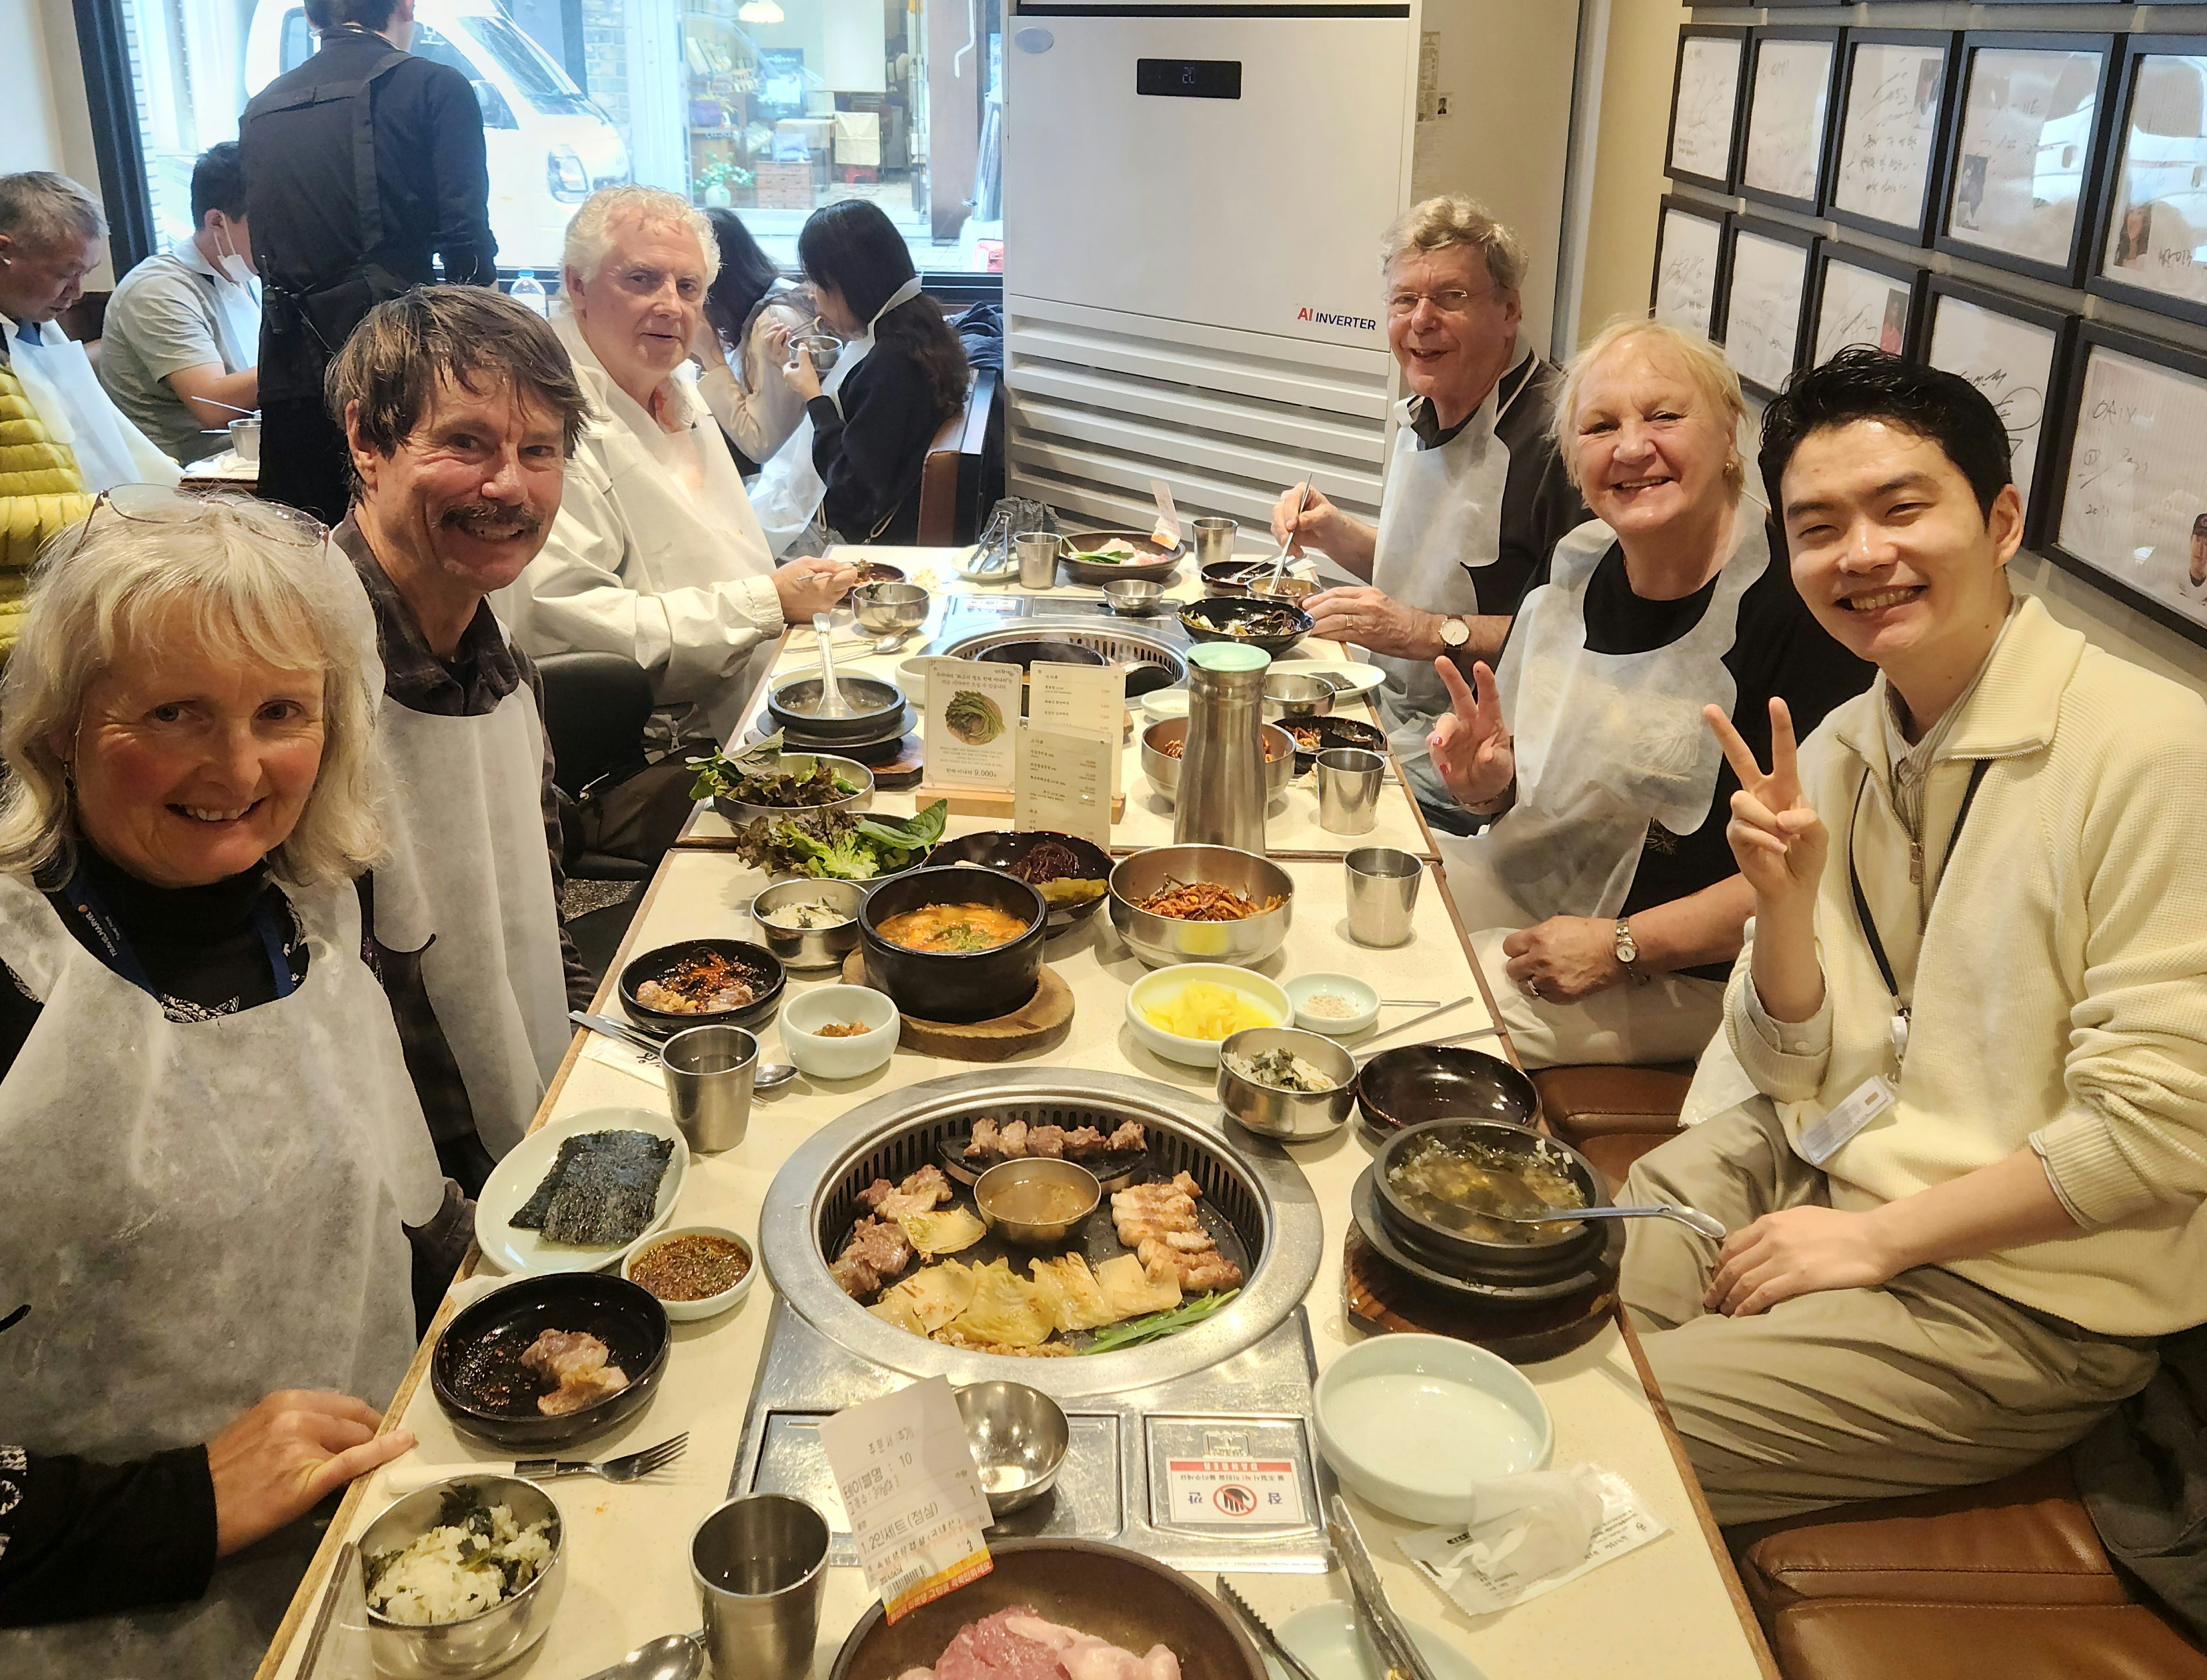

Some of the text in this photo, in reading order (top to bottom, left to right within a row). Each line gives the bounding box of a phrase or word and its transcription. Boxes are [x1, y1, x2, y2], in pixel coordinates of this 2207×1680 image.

[1297, 307, 1376, 330] AI INVERTER
[1203, 1462, 1258, 1471] DANGER
[843, 1467, 883, 1499] 테이블명
[899, 1452, 912, 1468] 10
[970, 1485, 976, 1497] 1
[1188, 1492, 1283, 1505] 잠 깐
